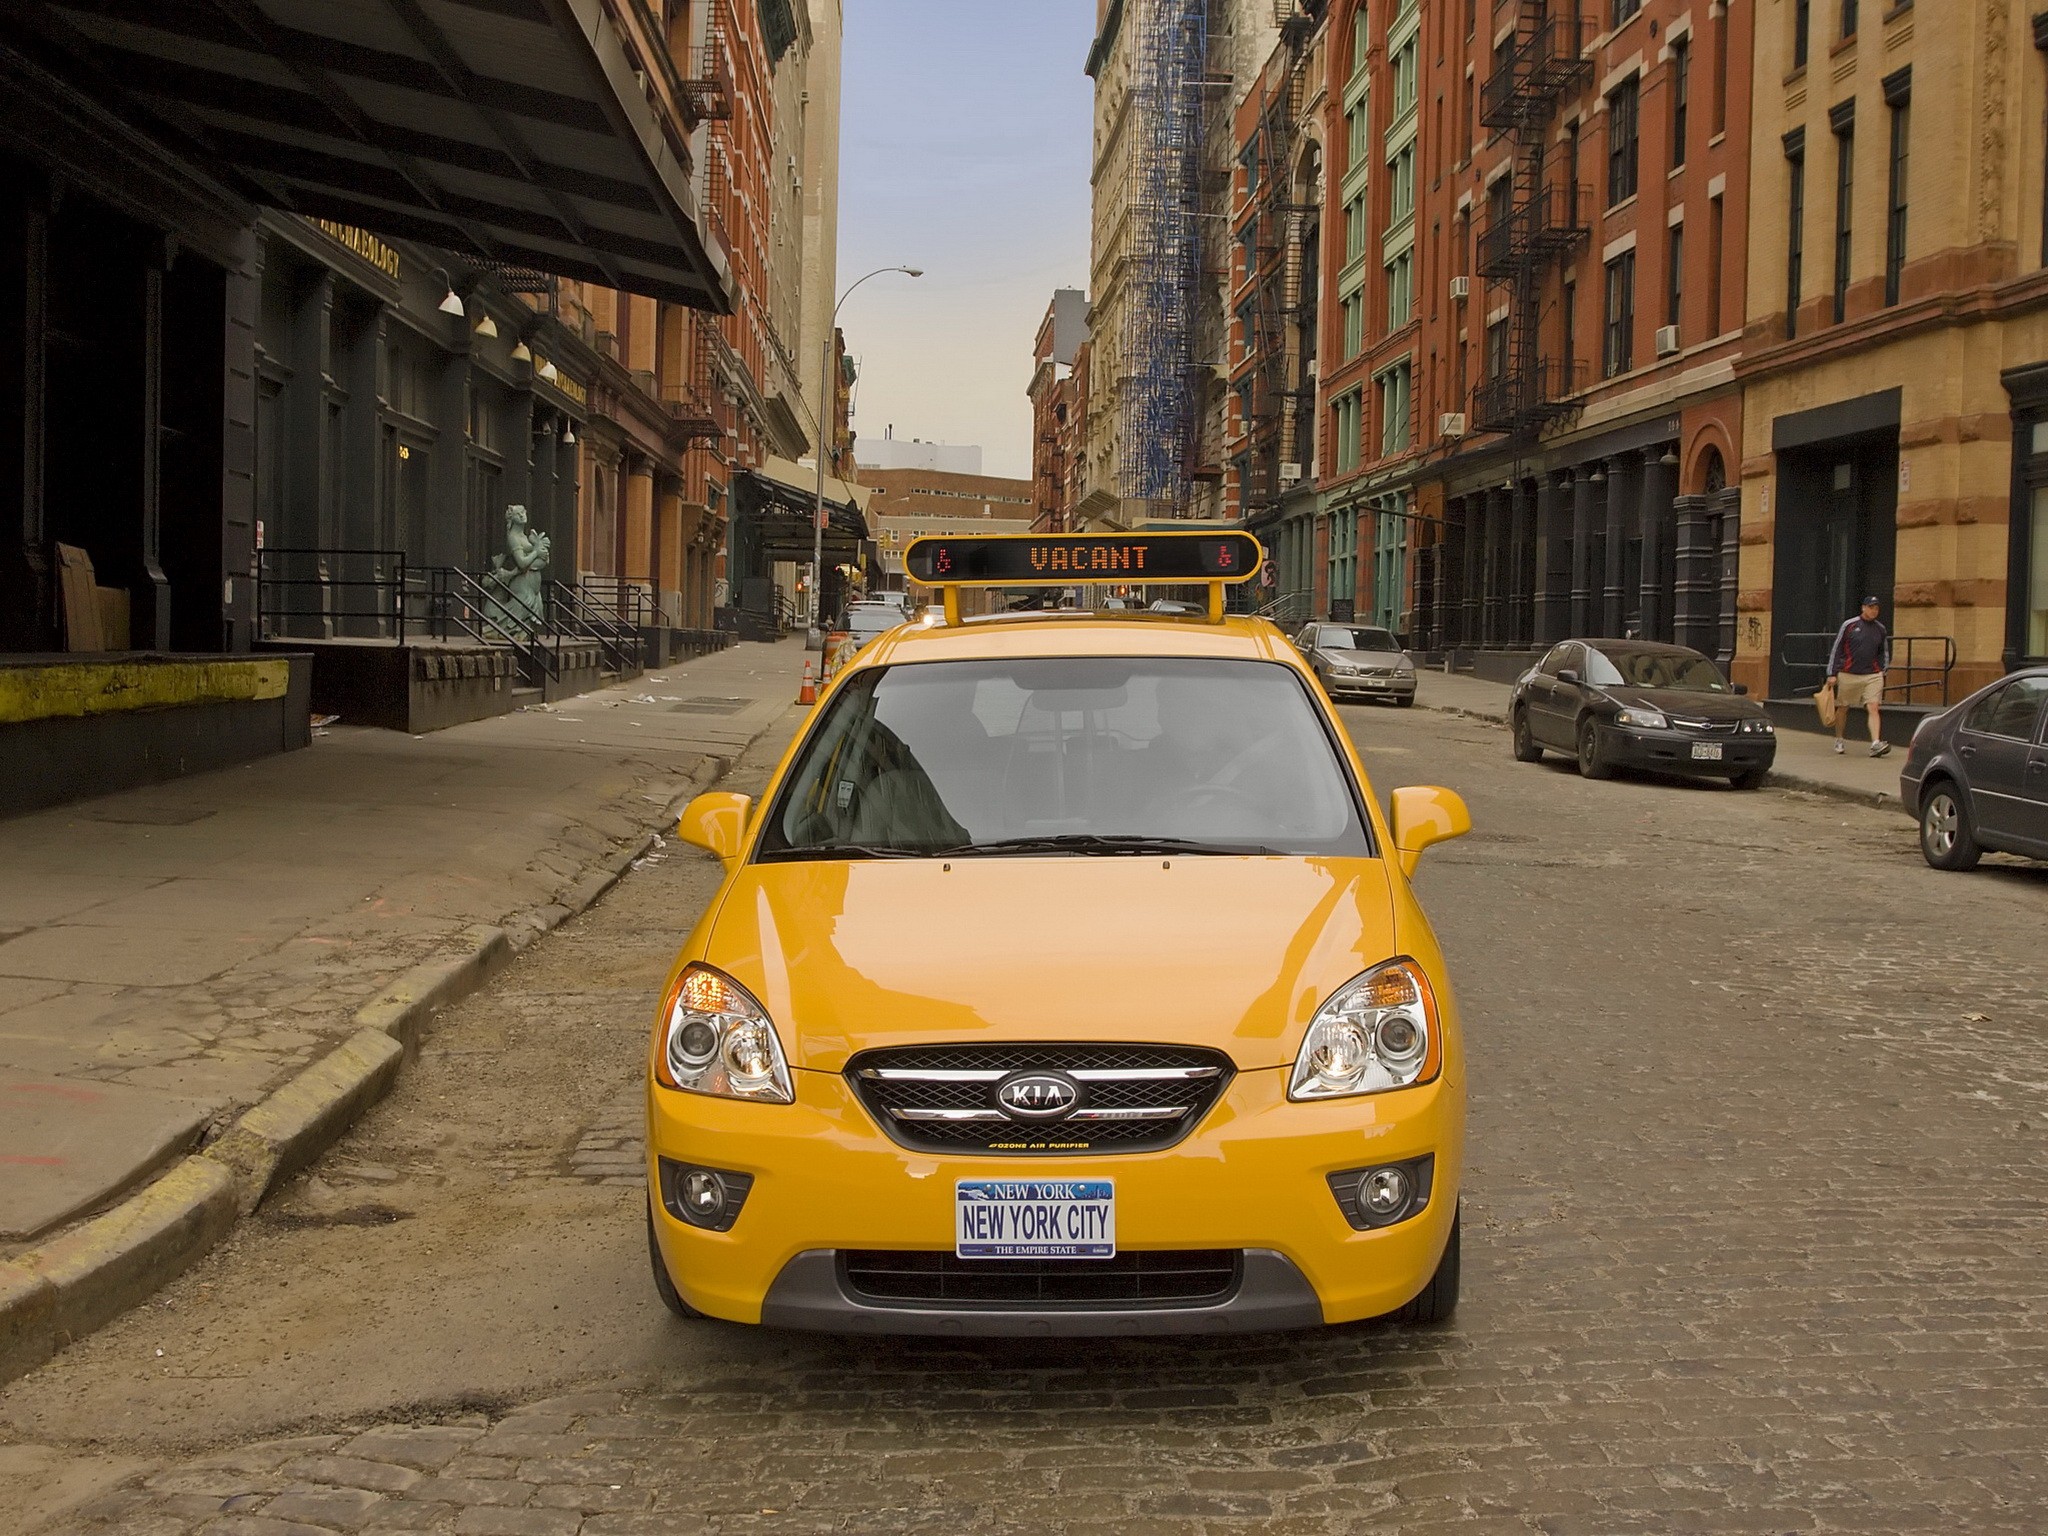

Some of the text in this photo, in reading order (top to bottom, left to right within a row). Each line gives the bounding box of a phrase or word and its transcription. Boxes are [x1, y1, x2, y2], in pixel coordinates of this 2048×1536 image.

[1030, 546, 1149, 571] VACANT
[1012, 1085, 1064, 1106] KIA
[994, 1184, 1078, 1200] NEW YORK
[963, 1204, 1110, 1240] NEW YORK CITY
[995, 1246, 1077, 1255] THE EMPIRE STATE
